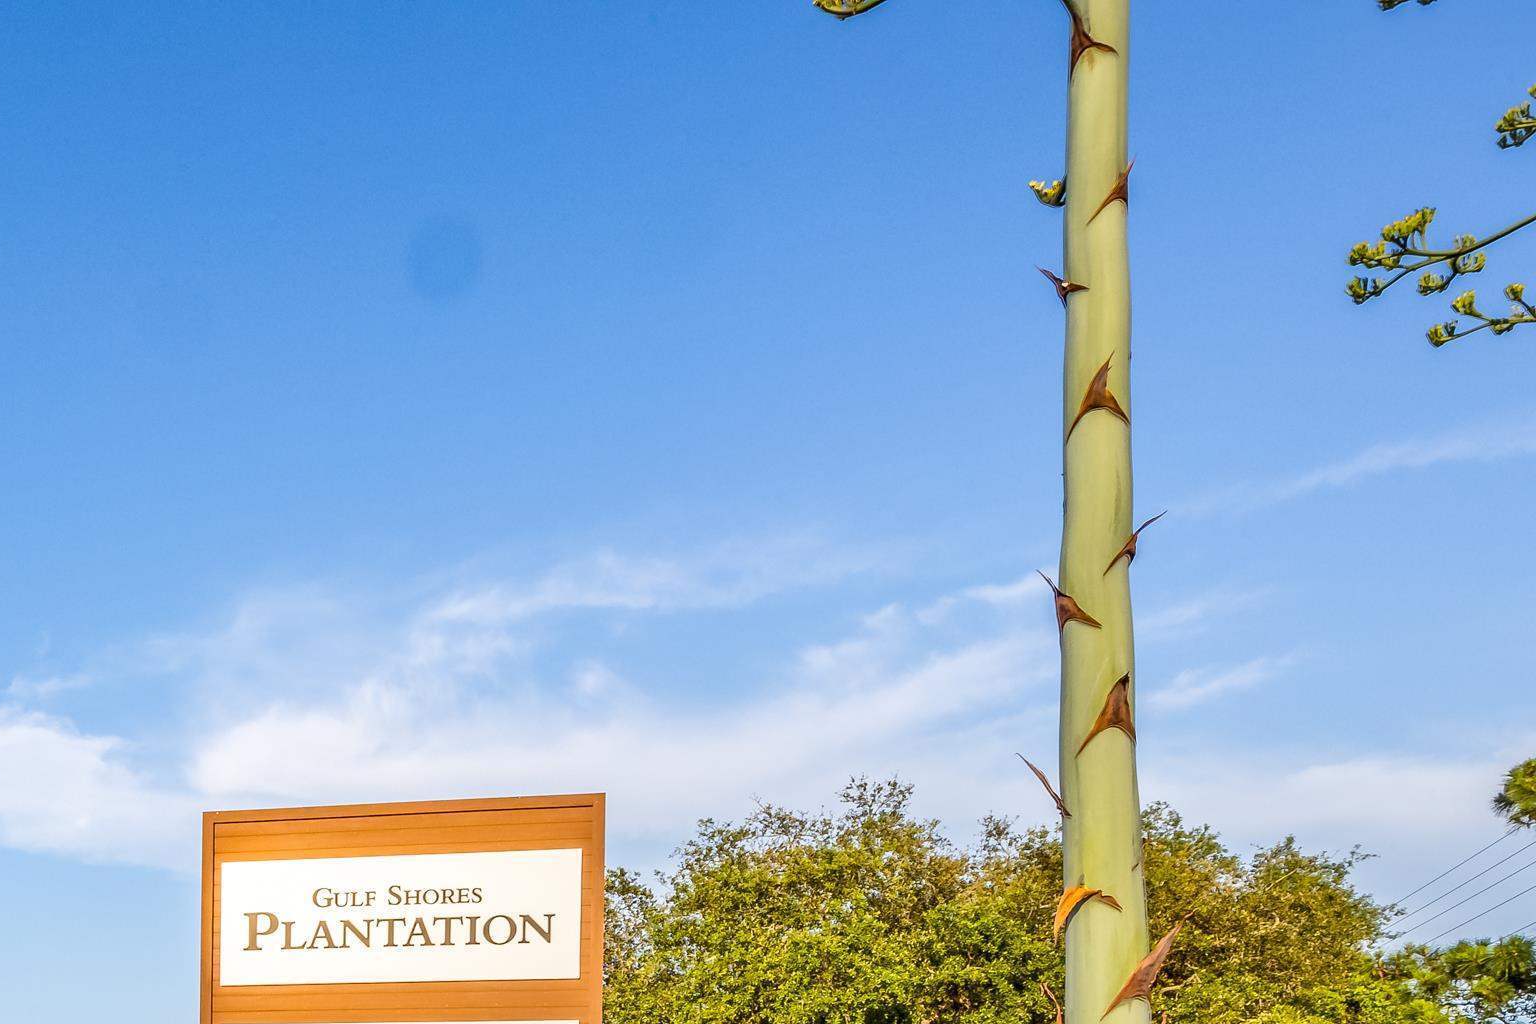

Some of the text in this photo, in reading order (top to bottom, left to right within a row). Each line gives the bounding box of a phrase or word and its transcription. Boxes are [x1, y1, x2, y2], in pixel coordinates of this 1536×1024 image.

[312, 884, 483, 908] GULF SHORES
[243, 911, 556, 951] PLANTATION
